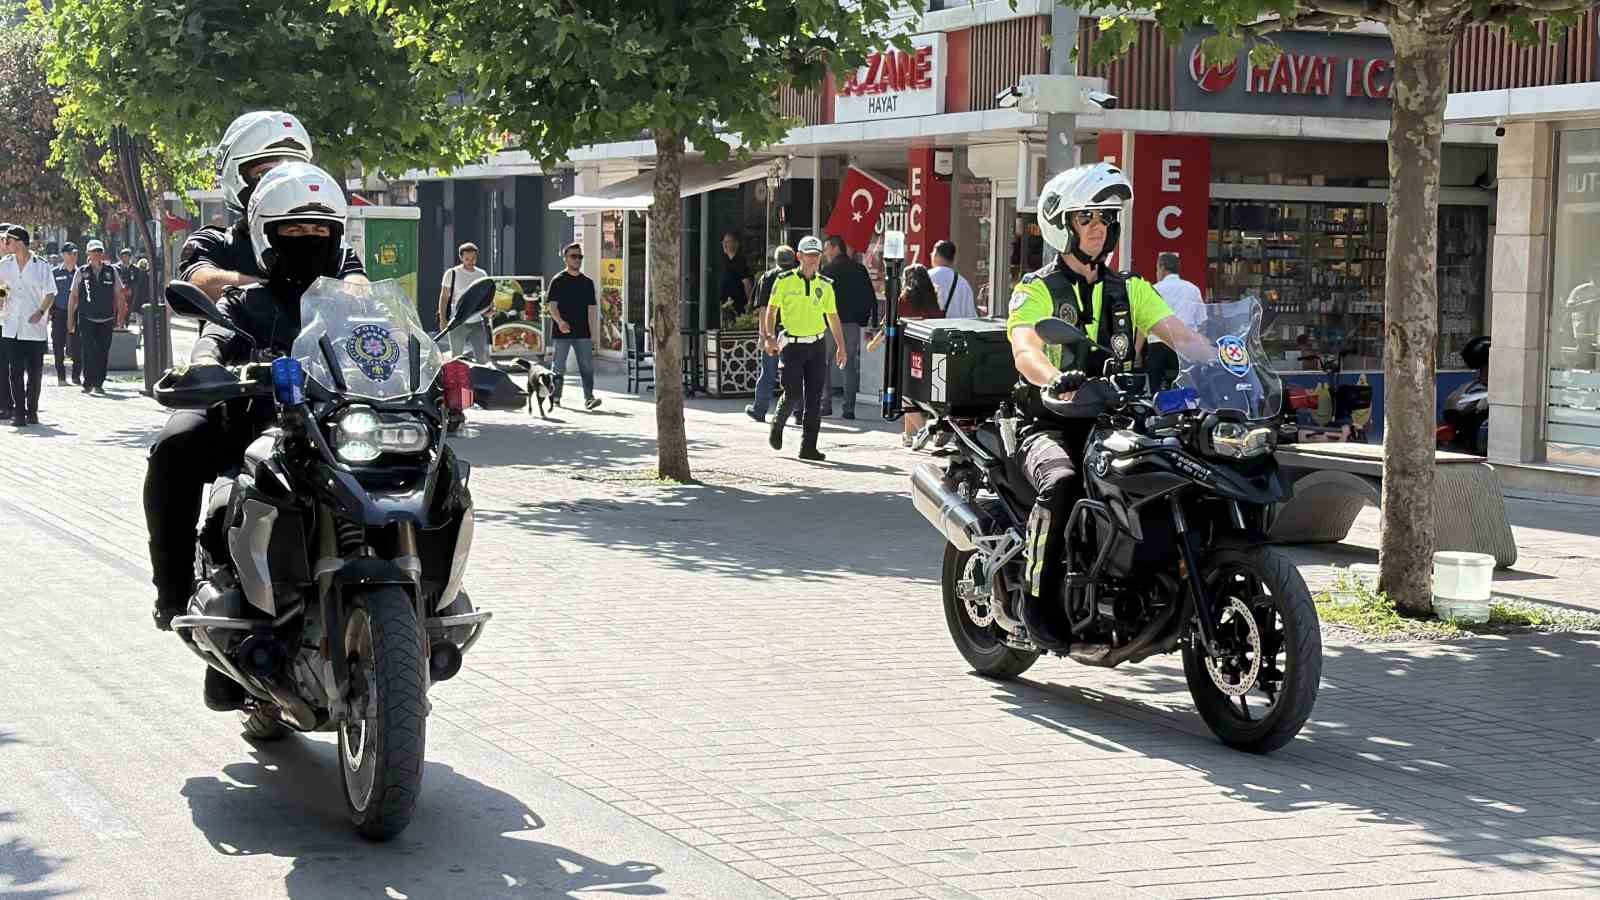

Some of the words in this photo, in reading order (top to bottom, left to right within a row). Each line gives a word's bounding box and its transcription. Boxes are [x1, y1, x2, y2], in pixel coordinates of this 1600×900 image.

[844, 46, 932, 95] ZANE
[1346, 54, 1394, 98] EC
[868, 96, 898, 113] HAYAT
